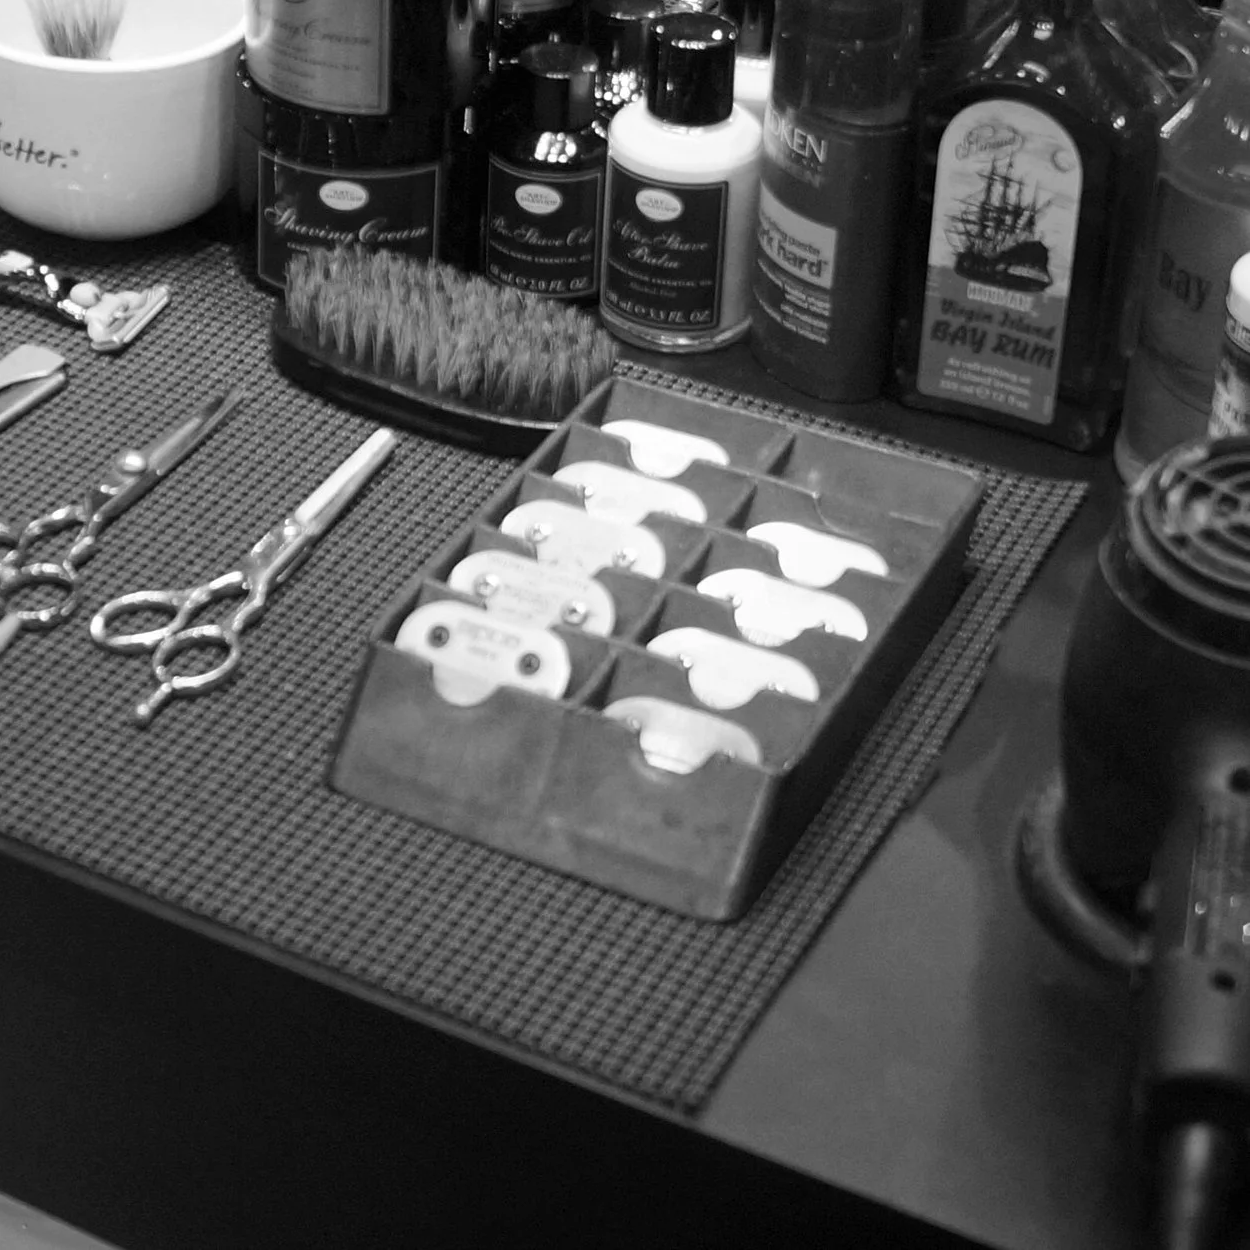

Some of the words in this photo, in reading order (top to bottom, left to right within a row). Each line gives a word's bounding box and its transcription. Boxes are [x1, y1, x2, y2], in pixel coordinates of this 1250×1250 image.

[263, 202, 356, 247] Shaving
[358, 217, 429, 244] Cream
[930, 319, 988, 355] BAY
[991, 332, 1056, 369] RUM
